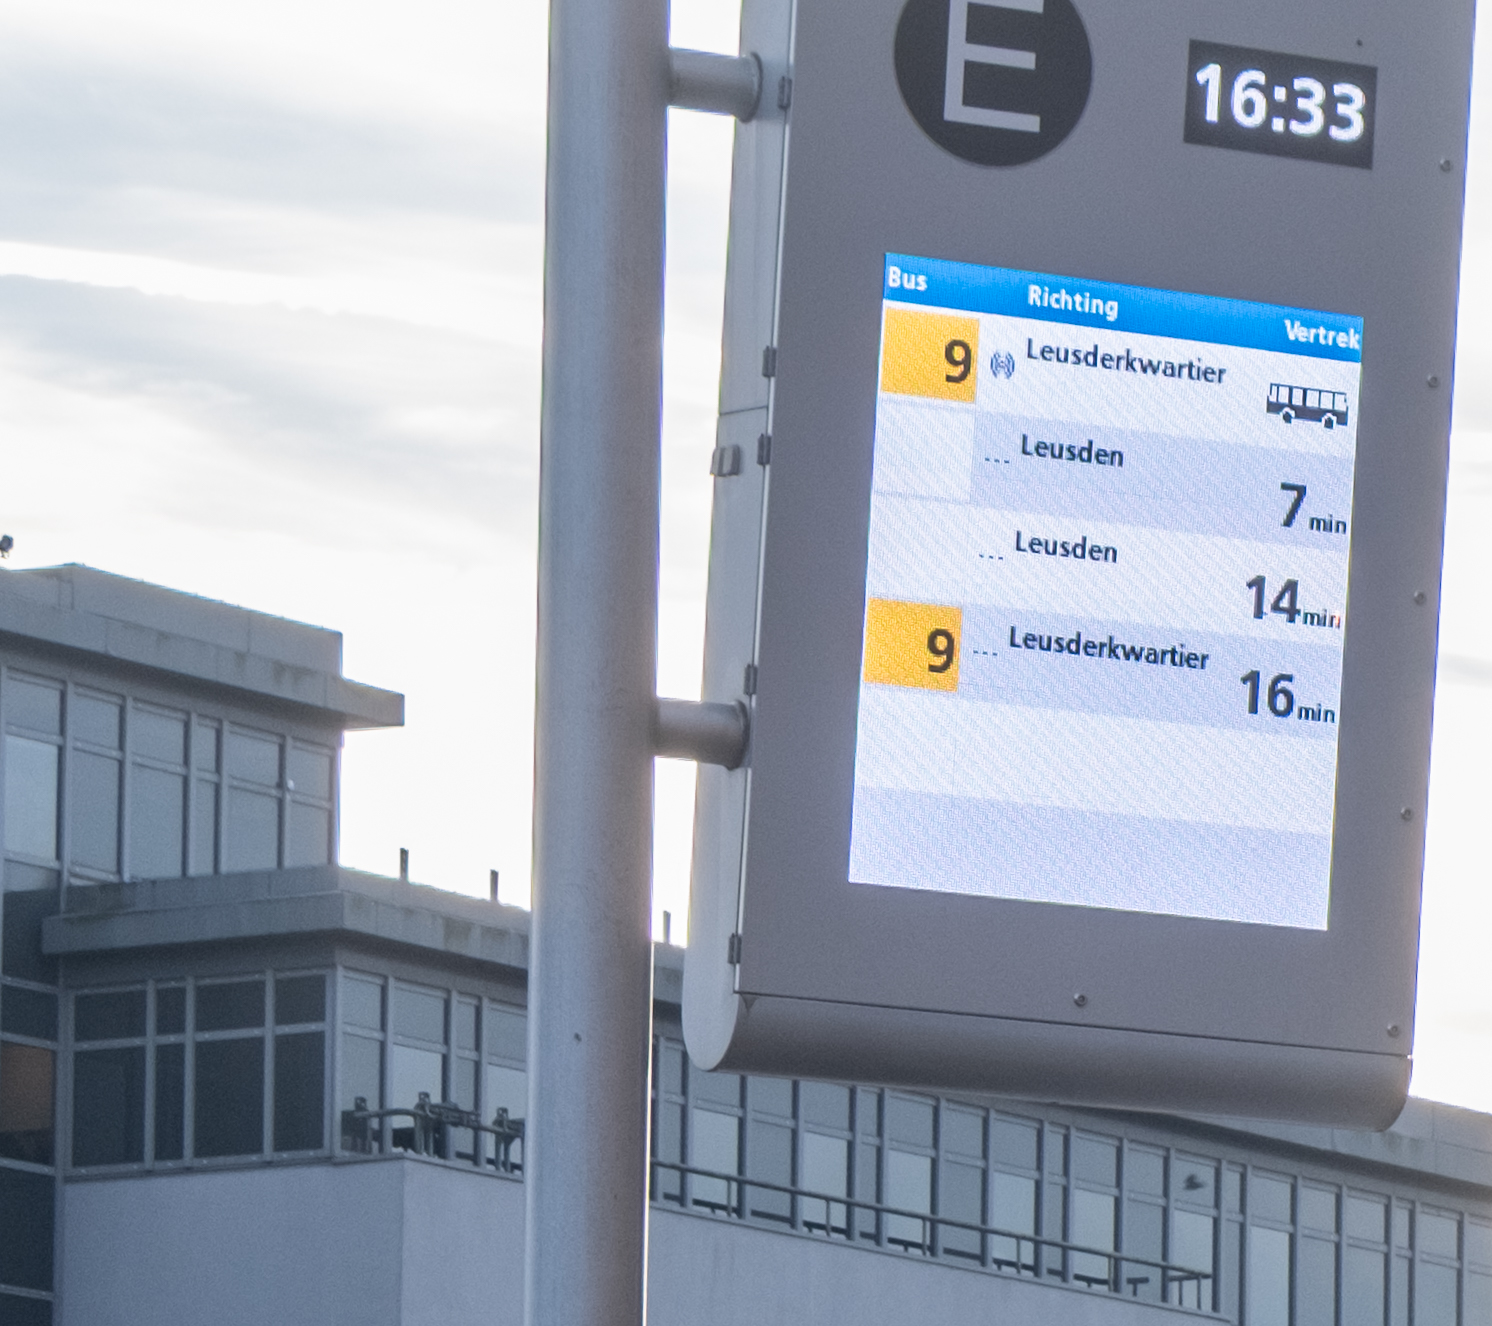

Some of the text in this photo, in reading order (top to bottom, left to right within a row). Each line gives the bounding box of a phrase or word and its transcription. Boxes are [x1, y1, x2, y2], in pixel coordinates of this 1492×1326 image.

[943, 0, 1043, 132] E
[1194, 61, 1369, 145] 16:33
[887, 266, 1361, 352] Bus Richting Vertrek
[942, 336, 1227, 386] 9 Leusderkwartier
[1020, 433, 1124, 470] Leusden
[1278, 481, 1348, 536] 7 min
[1015, 529, 1119, 564] Leusden
[1245, 573, 1341, 630] 14 min
[925, 625, 1209, 673] 9 Leusderkwartier
[1239, 668, 1337, 725] 16 min
